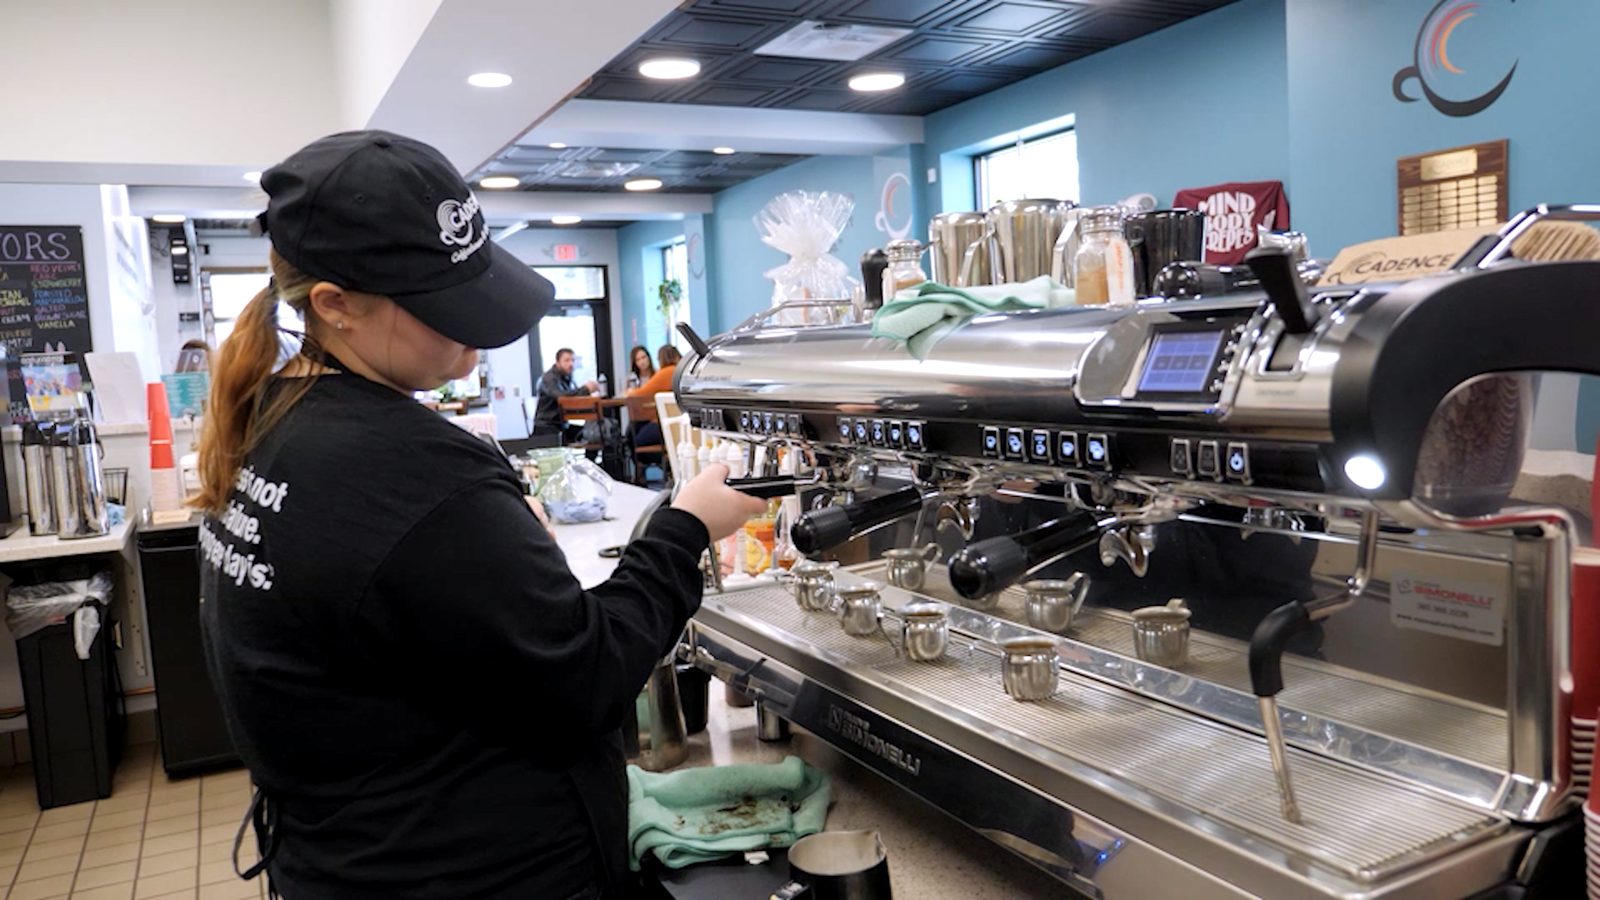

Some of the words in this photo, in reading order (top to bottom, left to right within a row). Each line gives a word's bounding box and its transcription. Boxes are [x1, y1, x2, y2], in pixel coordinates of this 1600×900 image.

[1198, 191, 1256, 216] MIND
[0, 231, 71, 260] ORS
[1354, 253, 1456, 275] CADENCE
[33, 289, 72, 298] TOASTED
[1, 313, 31, 324] CREAM
[37, 320, 76, 329] VANILLA
[1413, 585, 1493, 606] SIMONELLI
[841, 723, 921, 777] SIMONELLI
